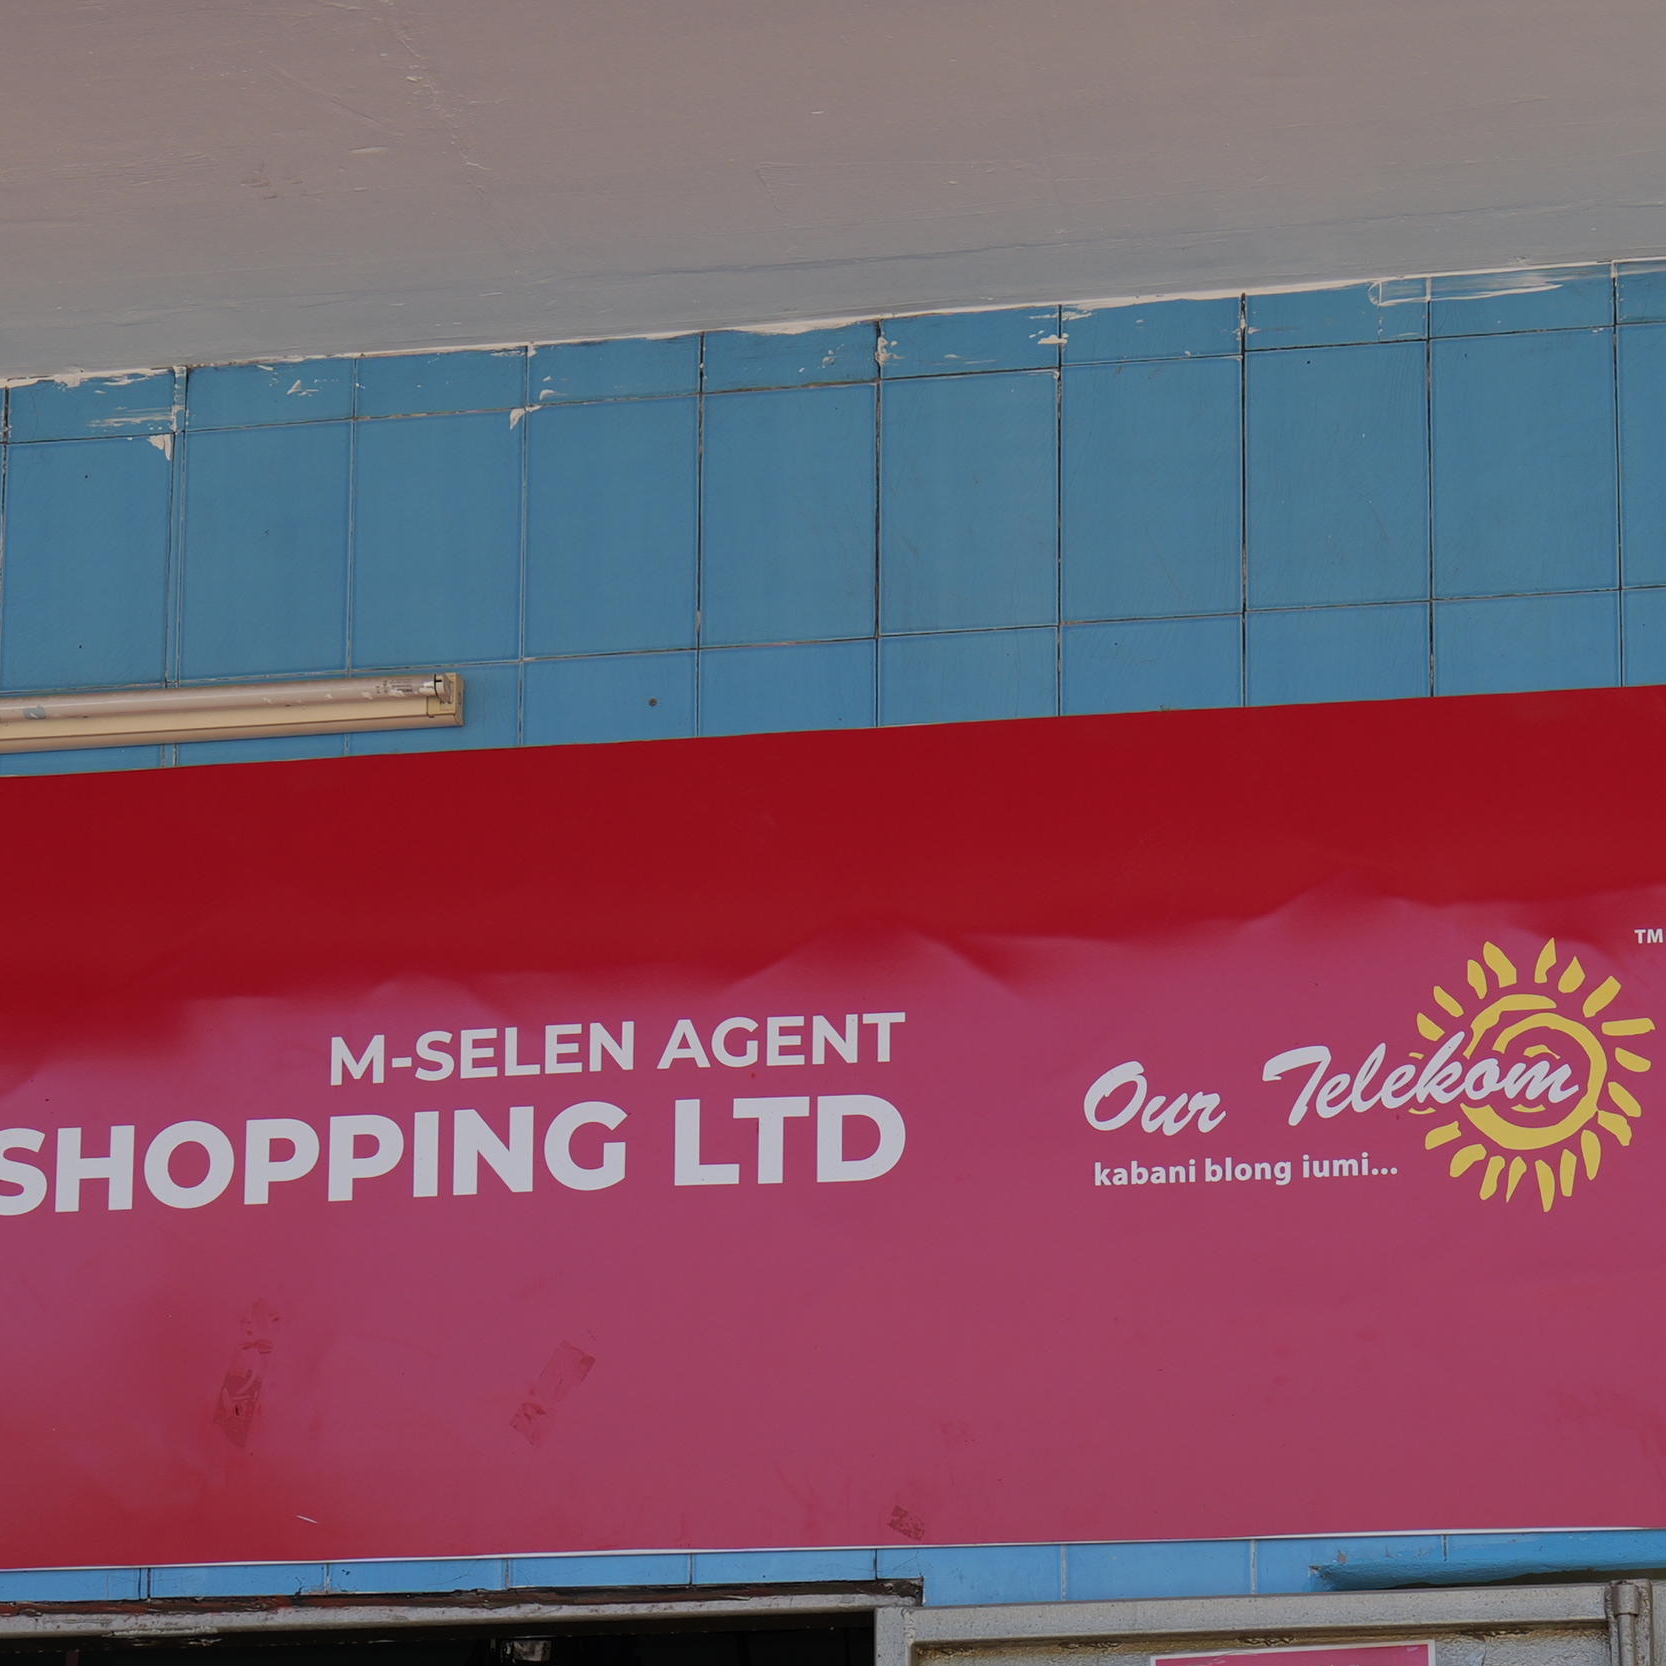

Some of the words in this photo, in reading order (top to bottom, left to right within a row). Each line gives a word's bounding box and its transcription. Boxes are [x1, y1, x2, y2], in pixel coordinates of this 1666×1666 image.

[329, 1022, 633, 1085] M-SELEN
[658, 1012, 906, 1070] AGENT
[1084, 1061, 1226, 1136] Our
[1263, 1031, 1579, 1126] Telekom
[674, 1094, 907, 1186] LTD
[1094, 1159, 1196, 1185] kabani
[1205, 1155, 1291, 1185] blong
[1302, 1153, 1398, 1178] iumi...
